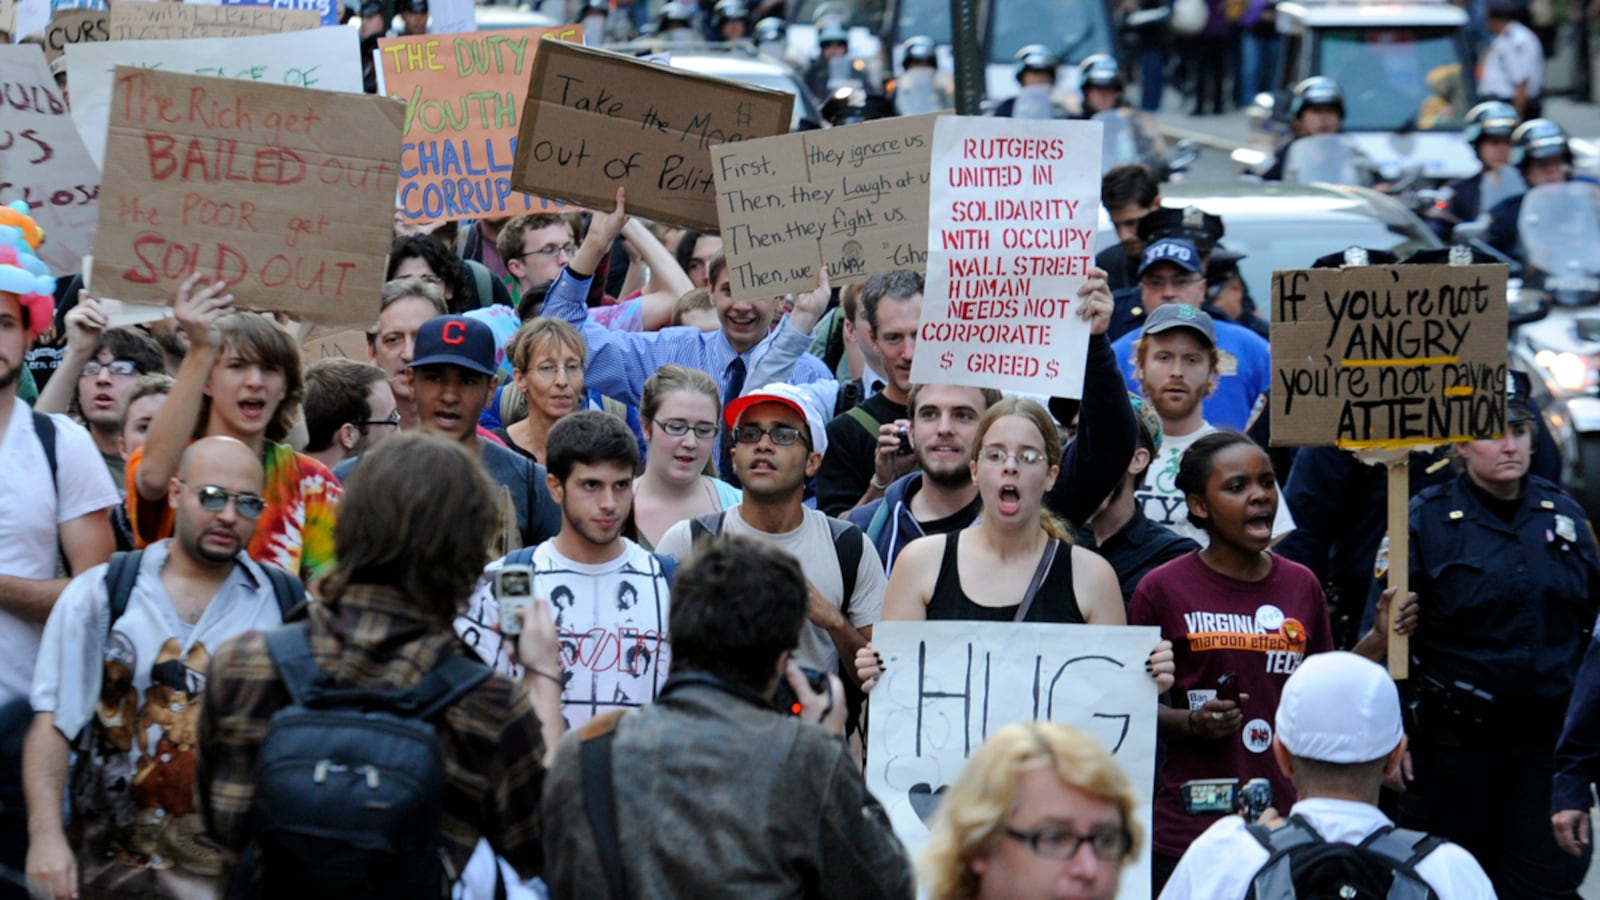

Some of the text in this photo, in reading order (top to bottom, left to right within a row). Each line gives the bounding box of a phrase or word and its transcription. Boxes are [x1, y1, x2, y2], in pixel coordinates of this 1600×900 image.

[384, 35, 528, 78] THE DUTY
[119, 72, 321, 146] The Rich get
[556, 74, 624, 117] Take
[640, 106, 669, 134] the
[145, 133, 305, 185] BAILED
[399, 137, 518, 179] CHALL
[808, 145, 845, 167] they
[850, 139, 900, 169] ignore
[963, 138, 1064, 160] RUTGERS
[790, 183, 834, 204] they
[843, 175, 891, 204] Laugh
[895, 171, 914, 189] at
[949, 164, 1053, 188] UNITED IN
[402, 177, 568, 219] CORRUP
[951, 199, 1080, 222] SOLIDARITY
[119, 192, 329, 247] the POOR get
[785, 220, 827, 240] they
[832, 206, 875, 236] fight
[941, 228, 1092, 250] WITH OCCUPY
[1146, 243, 1192, 264] NYPD
[123, 234, 356, 296] SOLD OUT
[790, 265, 813, 281] we
[949, 256, 1007, 278] WALL
[949, 277, 1031, 299] HUMAN
[947, 298, 1070, 321] NEEDS NOT
[1278, 269, 1489, 349] If you're not
[442, 320, 467, 345] C
[921, 322, 1051, 345] CORPORATE
[1343, 319, 1470, 361] ANGRY
[940, 351, 1060, 380] $ GREED $
[1279, 354, 1506, 416] you're not paying
[1337, 394, 1506, 440] ATTENTION
[1184, 611, 1267, 635] VIRGINIA
[1191, 634, 1246, 649] maroon
[915, 639, 1131, 759] HUG
